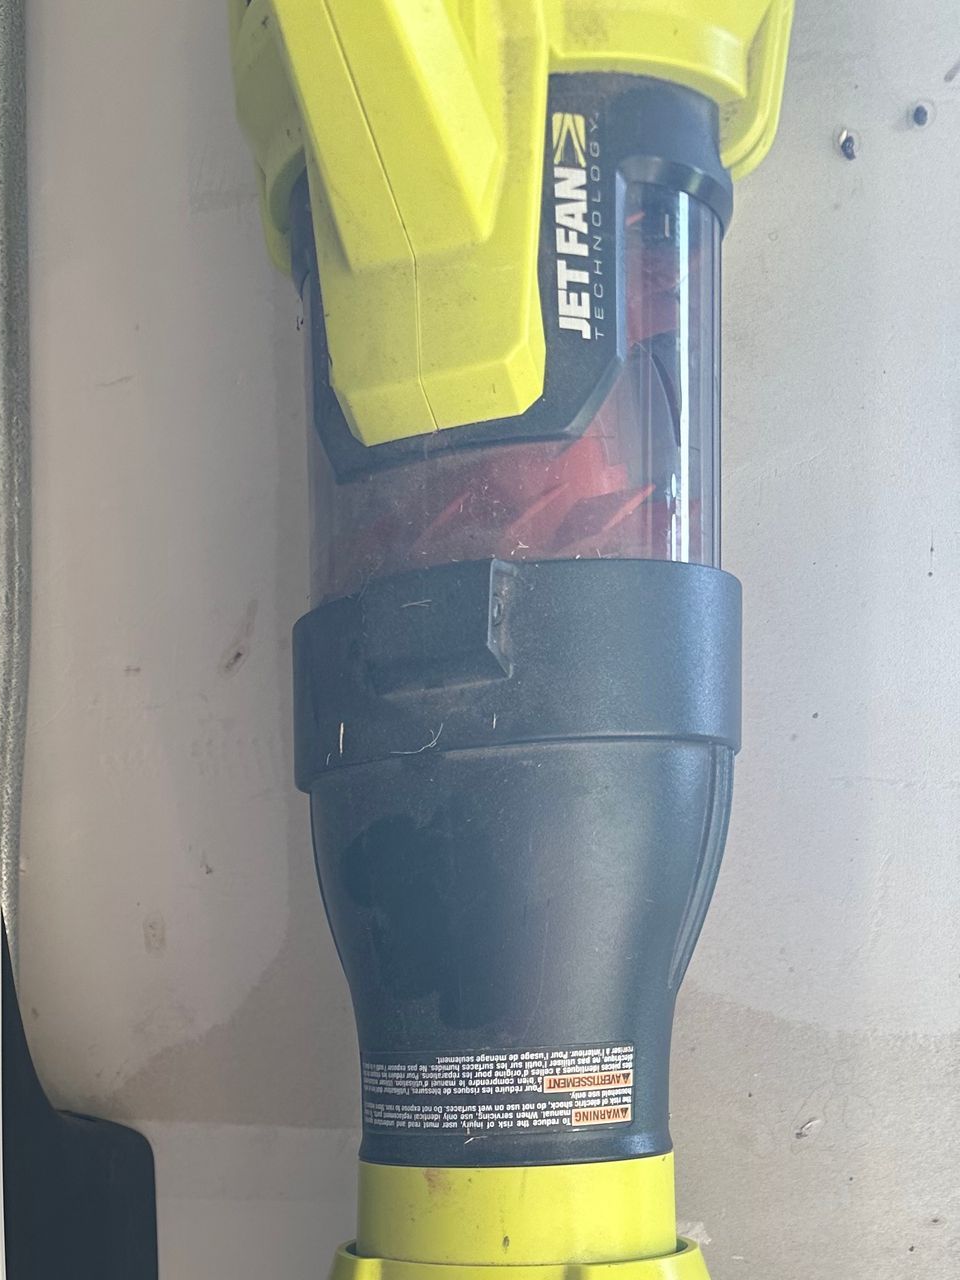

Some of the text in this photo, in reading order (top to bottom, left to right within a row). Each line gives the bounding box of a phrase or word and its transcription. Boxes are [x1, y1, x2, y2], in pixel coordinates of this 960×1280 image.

[589, 118, 605, 340] TECHNOLOGY
[553, 166, 591, 340] JET FAN
[476, 1054, 506, 1063] ménage
[509, 1055, 518, 1063] de
[521, 1052, 548, 1062] l'usage
[551, 1051, 568, 1059] Pour
[436, 1056, 474, 1064] seulement.
[550, 1058, 575, 1068] utiliser
[577, 1057, 590, 1066] pas
[429, 1064, 459, 1072] humides.
[462, 1063, 494, 1071] surfaces
[496, 1062, 508, 1070] les
[510, 1062, 522, 1070] sur
[525, 1061, 547, 1069] l'outil
[563, 1064, 600, 1074] identiques
[475, 1070, 492, 1079] pour
[494, 1070, 528, 1080] d'origine
[531, 1069, 554, 1077] celles
[431, 1080, 456, 1088] manuel
[468, 1078, 514, 1087] comprendre
[547, 1074, 621, 1089] AVERTISSEMENT
[452, 1086, 479, 1095] risques
[495, 1086, 522, 1096] réduire
[525, 1084, 542, 1092] Pour
[575, 1099, 600, 1108] electric
[602, 1098, 608, 1106] of
[610, 1097, 621, 1105] risk
[622, 1096, 631, 1104] the
[444, 1105, 476, 1113] surfaces.
[479, 1105, 492, 1113] wet
[495, 1104, 504, 1112] on
[522, 1103, 535, 1111] not
[537, 1103, 546, 1111] do
[548, 1101, 573, 1109] shock,
[443, 1112, 457, 1121] only
[476, 1111, 513, 1121] servicing,
[516, 1111, 538, 1119] When
[541, 1110, 571, 1119] manual.
[575, 1109, 620, 1122] WARNING
[461, 1120, 483, 1129] injury,
[487, 1121, 494, 1129] of
[533, 1118, 559, 1127] reduce
[562, 1118, 571, 1126] To
